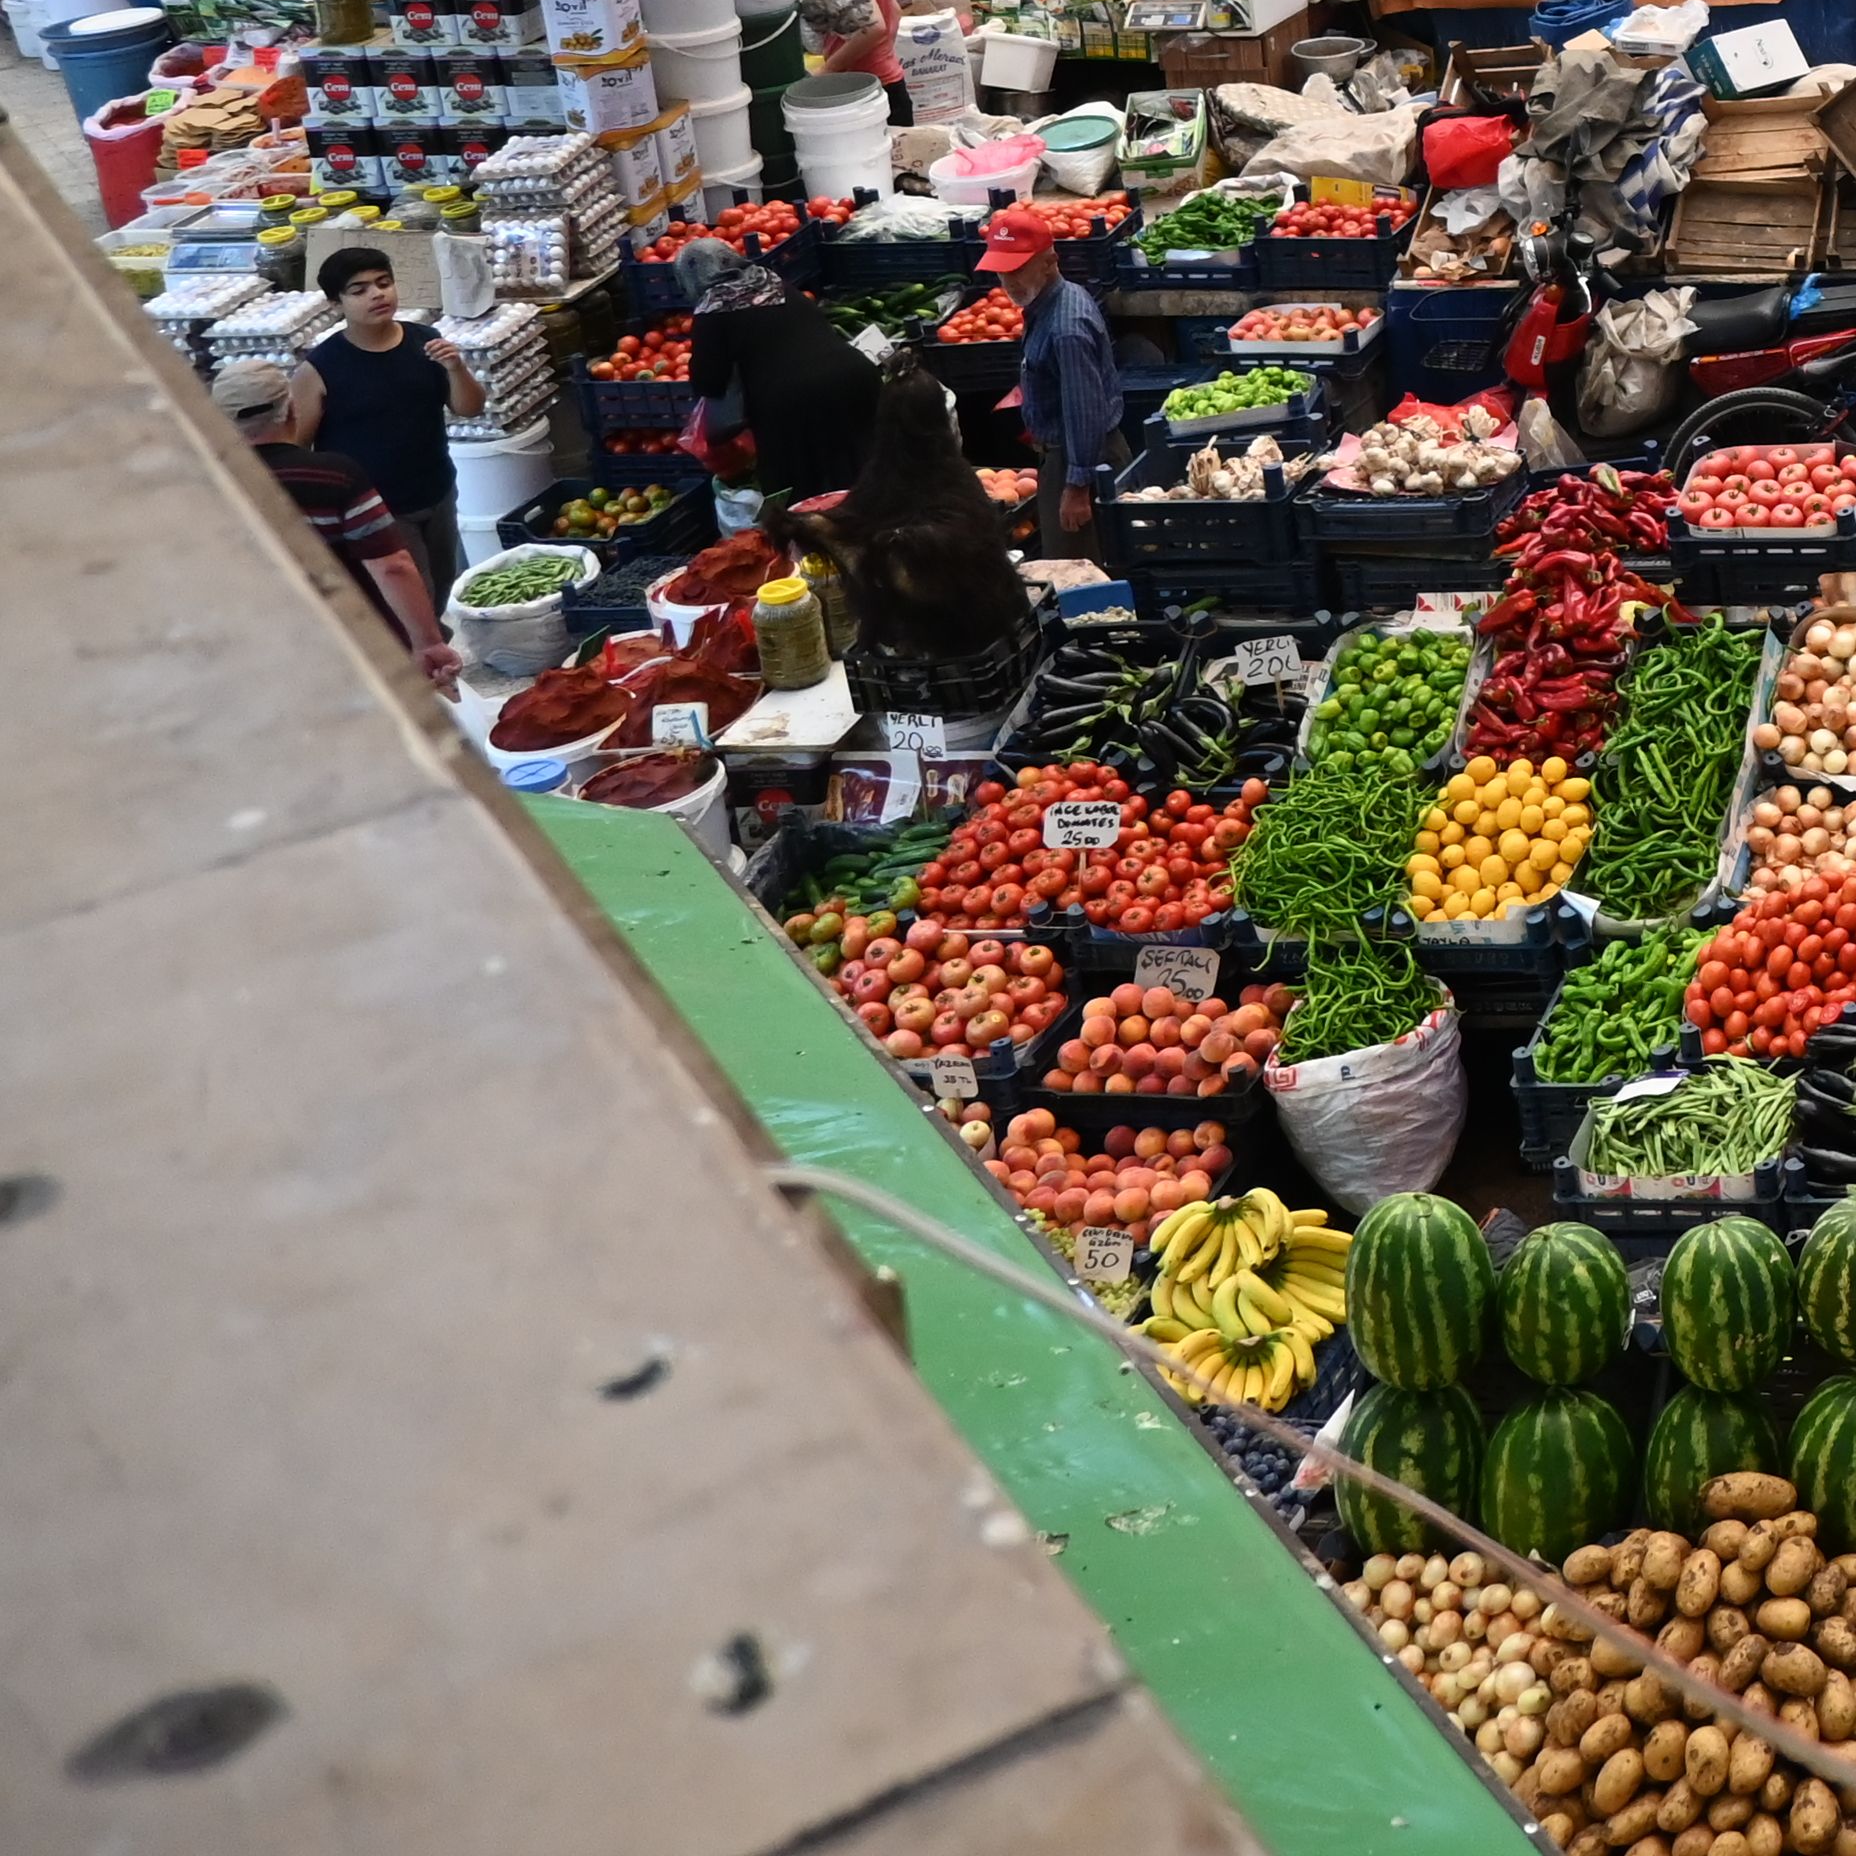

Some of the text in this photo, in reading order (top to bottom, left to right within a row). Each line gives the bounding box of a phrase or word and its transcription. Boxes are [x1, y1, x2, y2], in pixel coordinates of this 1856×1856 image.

[406, 10, 432, 22] Cem
[473, 10, 499, 22] Cem
[323, 81, 350, 93] Cem
[390, 81, 416, 93] Cem
[457, 81, 482, 93] Cem
[327, 150, 354, 163] Cem
[398, 150, 424, 163] Cem
[1084, 1249, 1119, 1271] 50
